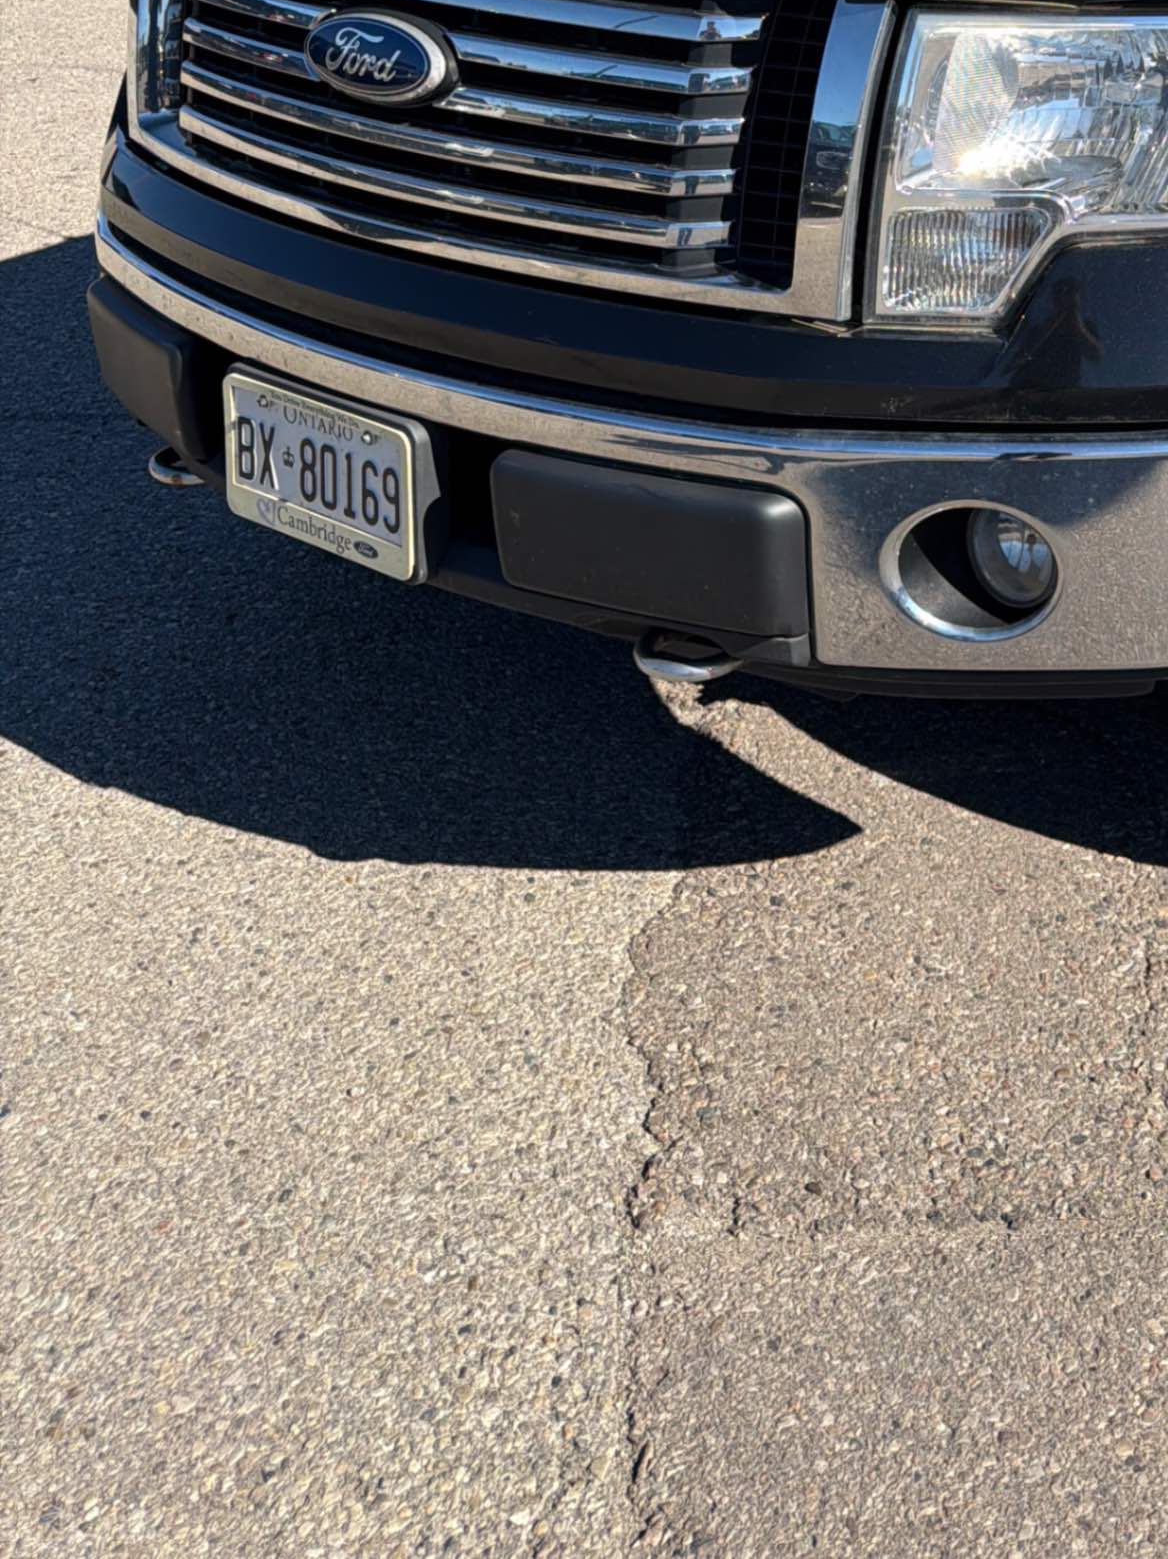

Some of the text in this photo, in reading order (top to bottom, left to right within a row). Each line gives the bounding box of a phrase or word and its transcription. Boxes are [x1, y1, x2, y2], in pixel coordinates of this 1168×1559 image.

[325, 27, 401, 81] Ford
[283, 405, 353, 441] ONTARIO
[237, 416, 400, 534] BX 80169
[277, 505, 352, 554] Cambridge
